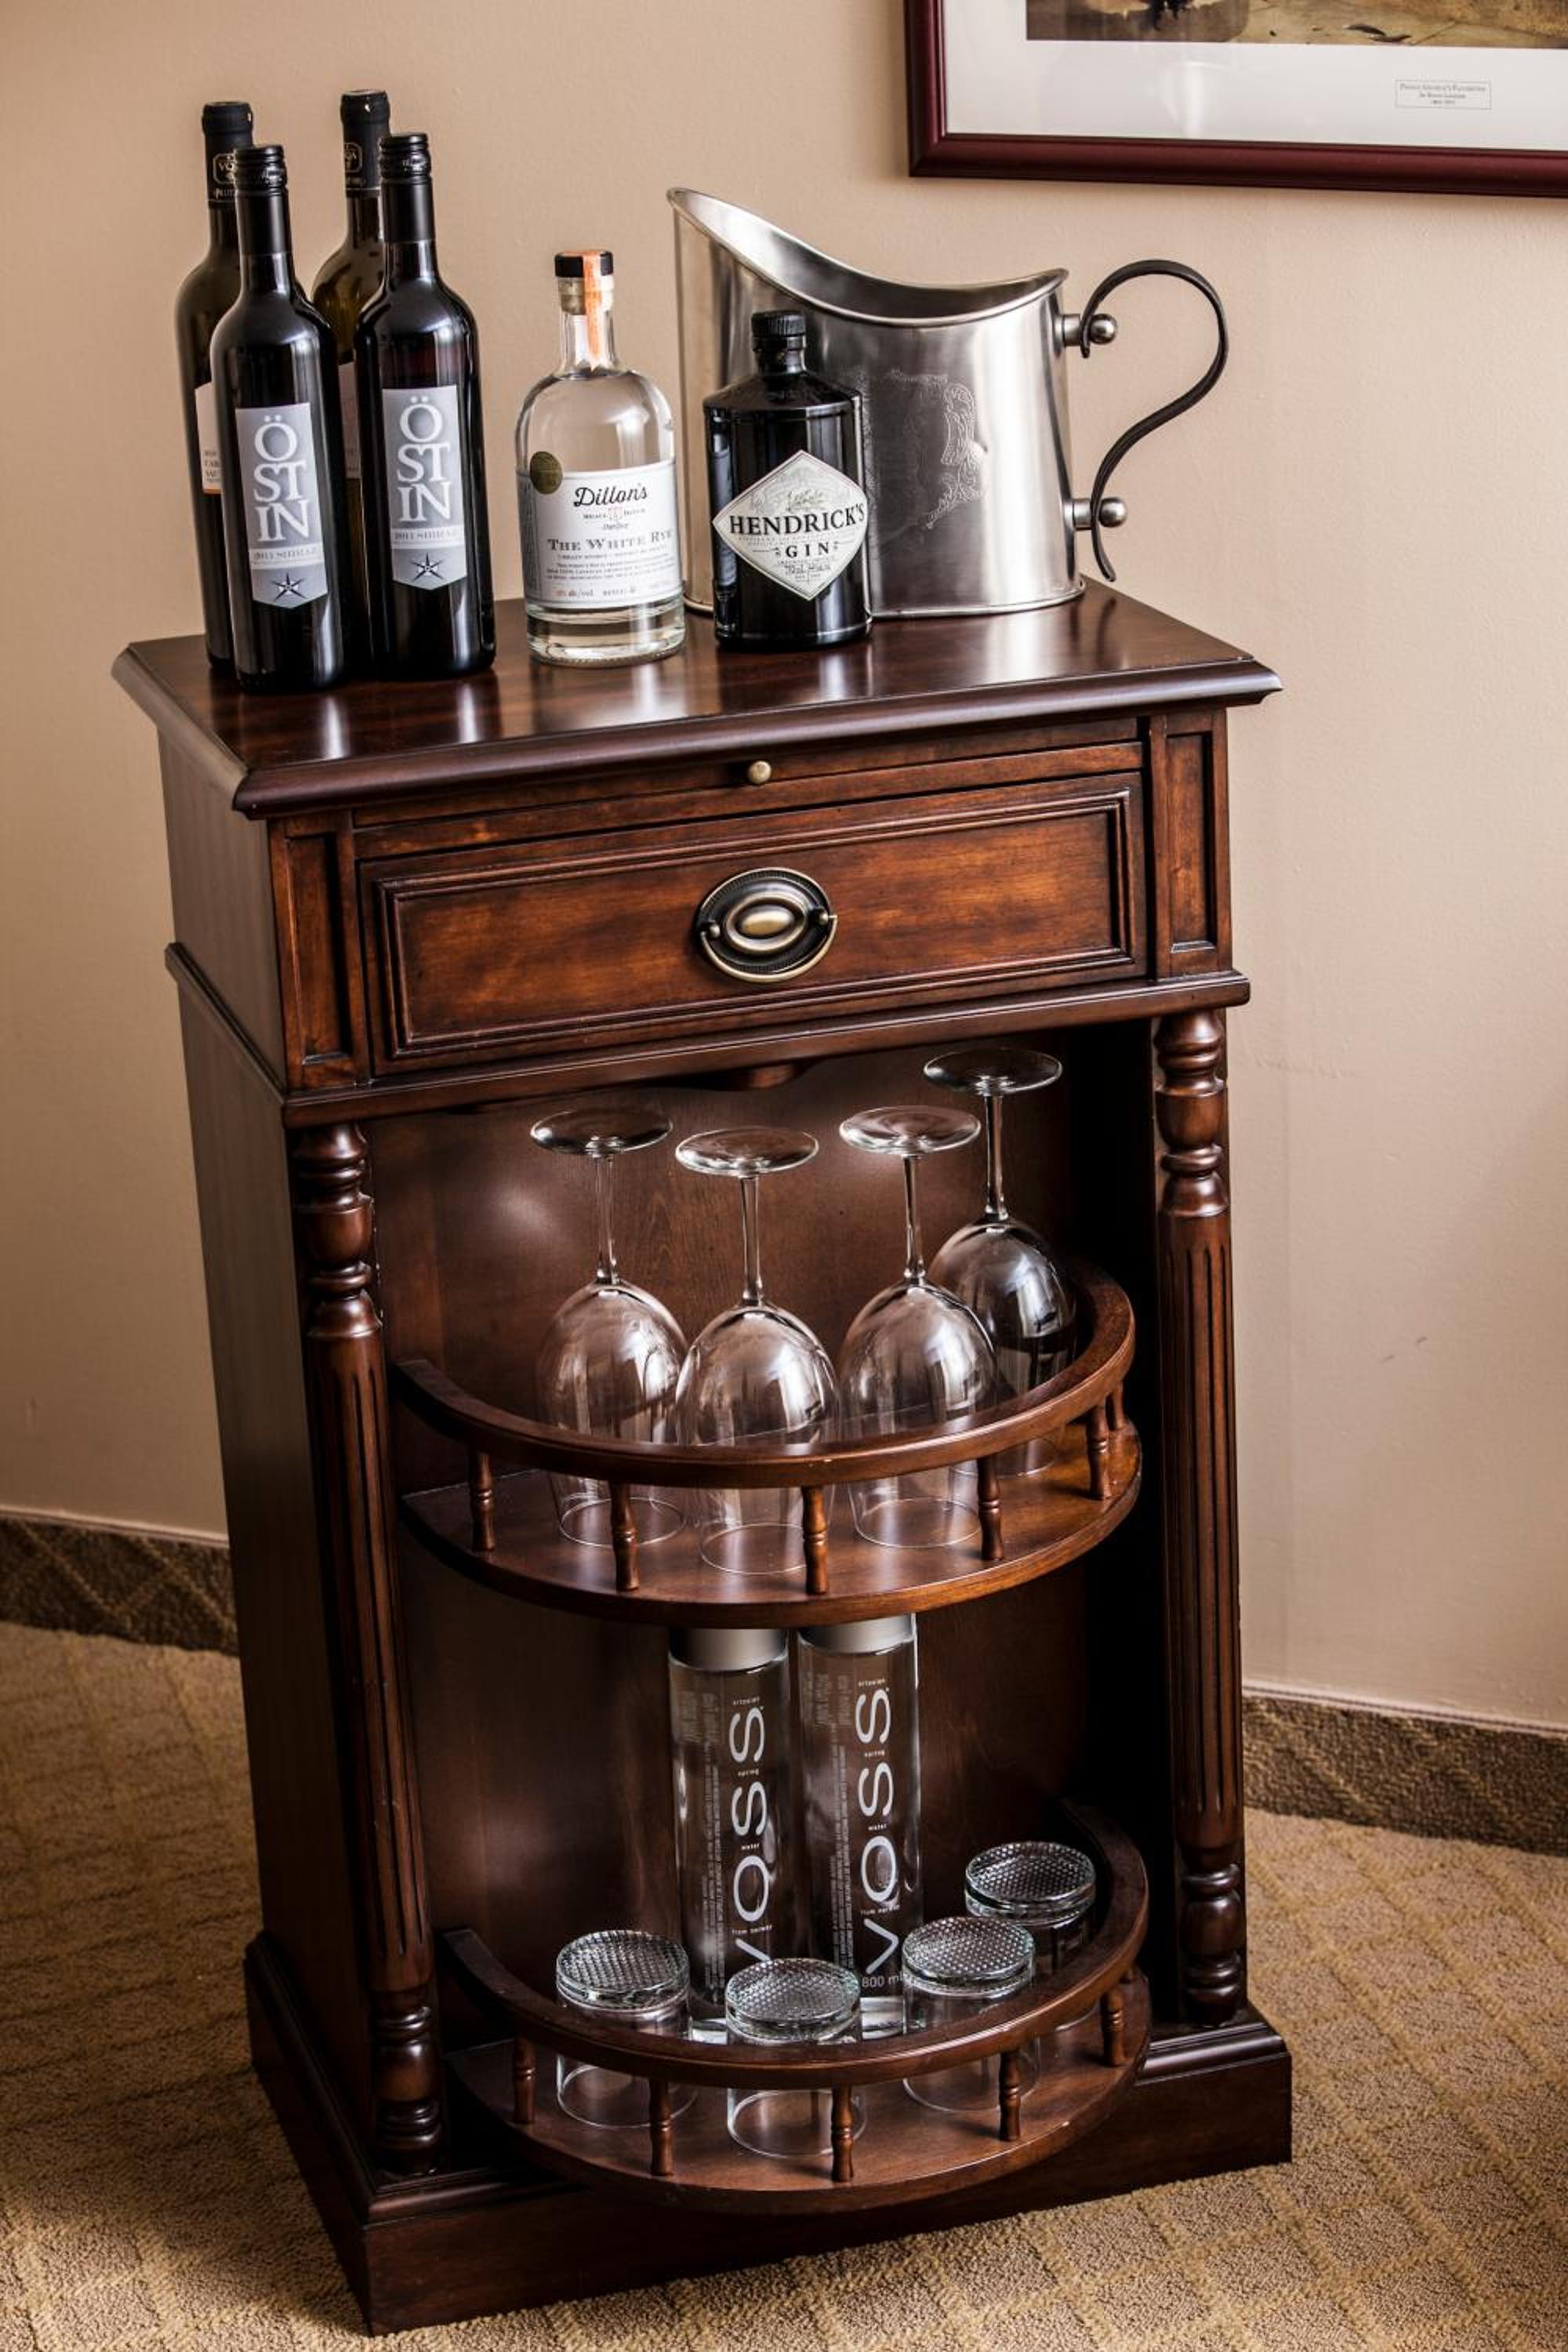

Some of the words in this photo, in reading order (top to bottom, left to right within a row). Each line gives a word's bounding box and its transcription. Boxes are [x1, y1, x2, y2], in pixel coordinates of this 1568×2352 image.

[573, 482, 648, 507] Dillon's
[729, 503, 865, 535] HENDRICK'S
[546, 539, 581, 551] THE
[585, 536, 646, 550] WHITE
[785, 542, 829, 558] GIN
[855, 1689, 899, 1975] VOSS
[862, 1976, 885, 1988] 800
